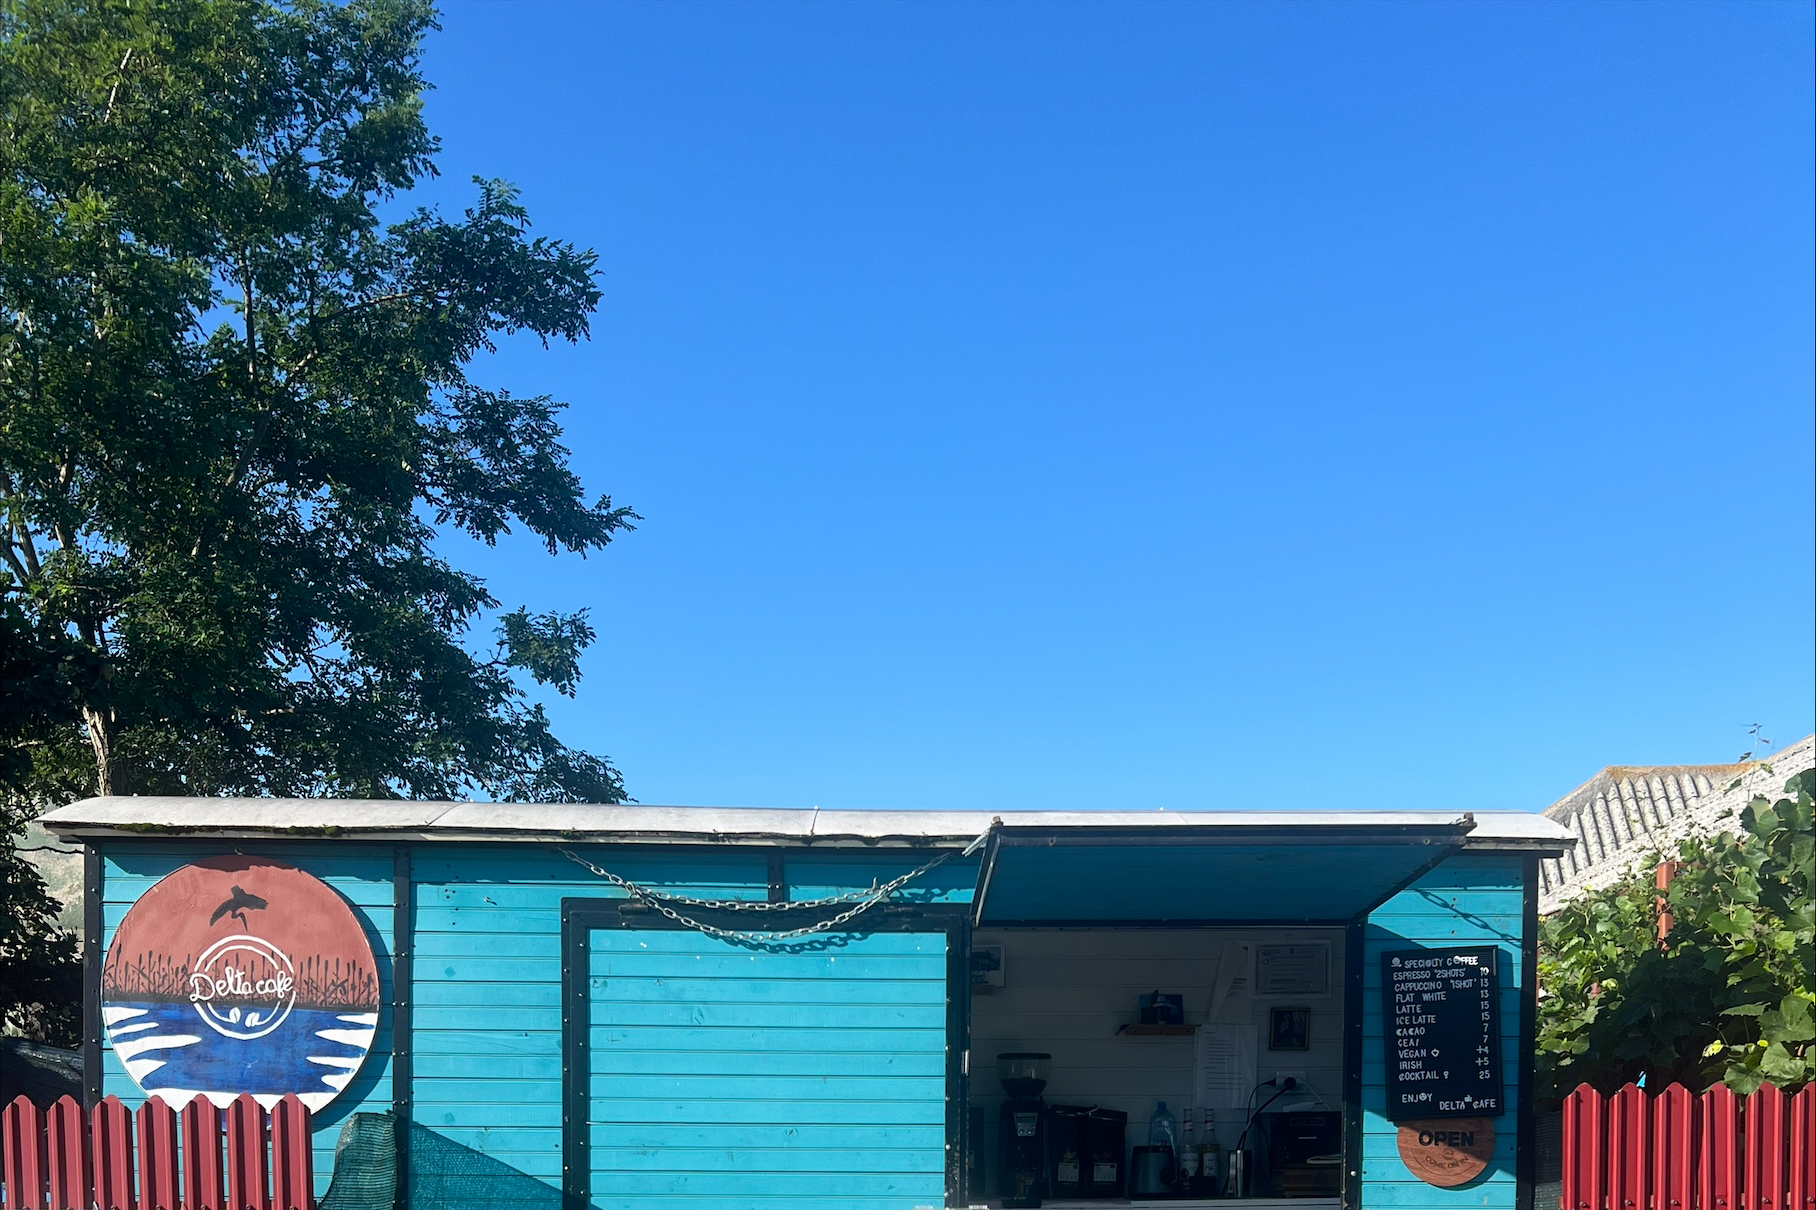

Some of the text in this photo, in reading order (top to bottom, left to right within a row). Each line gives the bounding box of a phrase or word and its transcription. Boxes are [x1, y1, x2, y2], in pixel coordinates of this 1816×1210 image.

[1393, 970, 1431, 980] ESPRESSO
[1480, 967, 1490, 976] 10
[189, 966, 294, 1002] Delta cafe
[1394, 981, 1442, 992] CAPPUCCINO
[1480, 978, 1489, 988] 13
[1395, 989, 1490, 1003] FLAT WHITE 13
[1396, 1001, 1490, 1014] LATTE 15
[1396, 1011, 1490, 1025] ICE LATTE 15
[1395, 1023, 1489, 1037] CACAO 7
[1483, 1034, 1489, 1044] 7
[1398, 1045, 1489, 1059] VEGAN +4
[1399, 1057, 1490, 1070] IRISH +5
[1398, 1069, 1491, 1081] COCKTAIL 25
[1401, 1092, 1433, 1103] ENJOY
[1439, 1098, 1497, 1111] DELTA CAFE
[1418, 1130, 1474, 1146] OPEN
[1425, 1155, 1447, 1170] COME
[1460, 1155, 1469, 1164] IN
